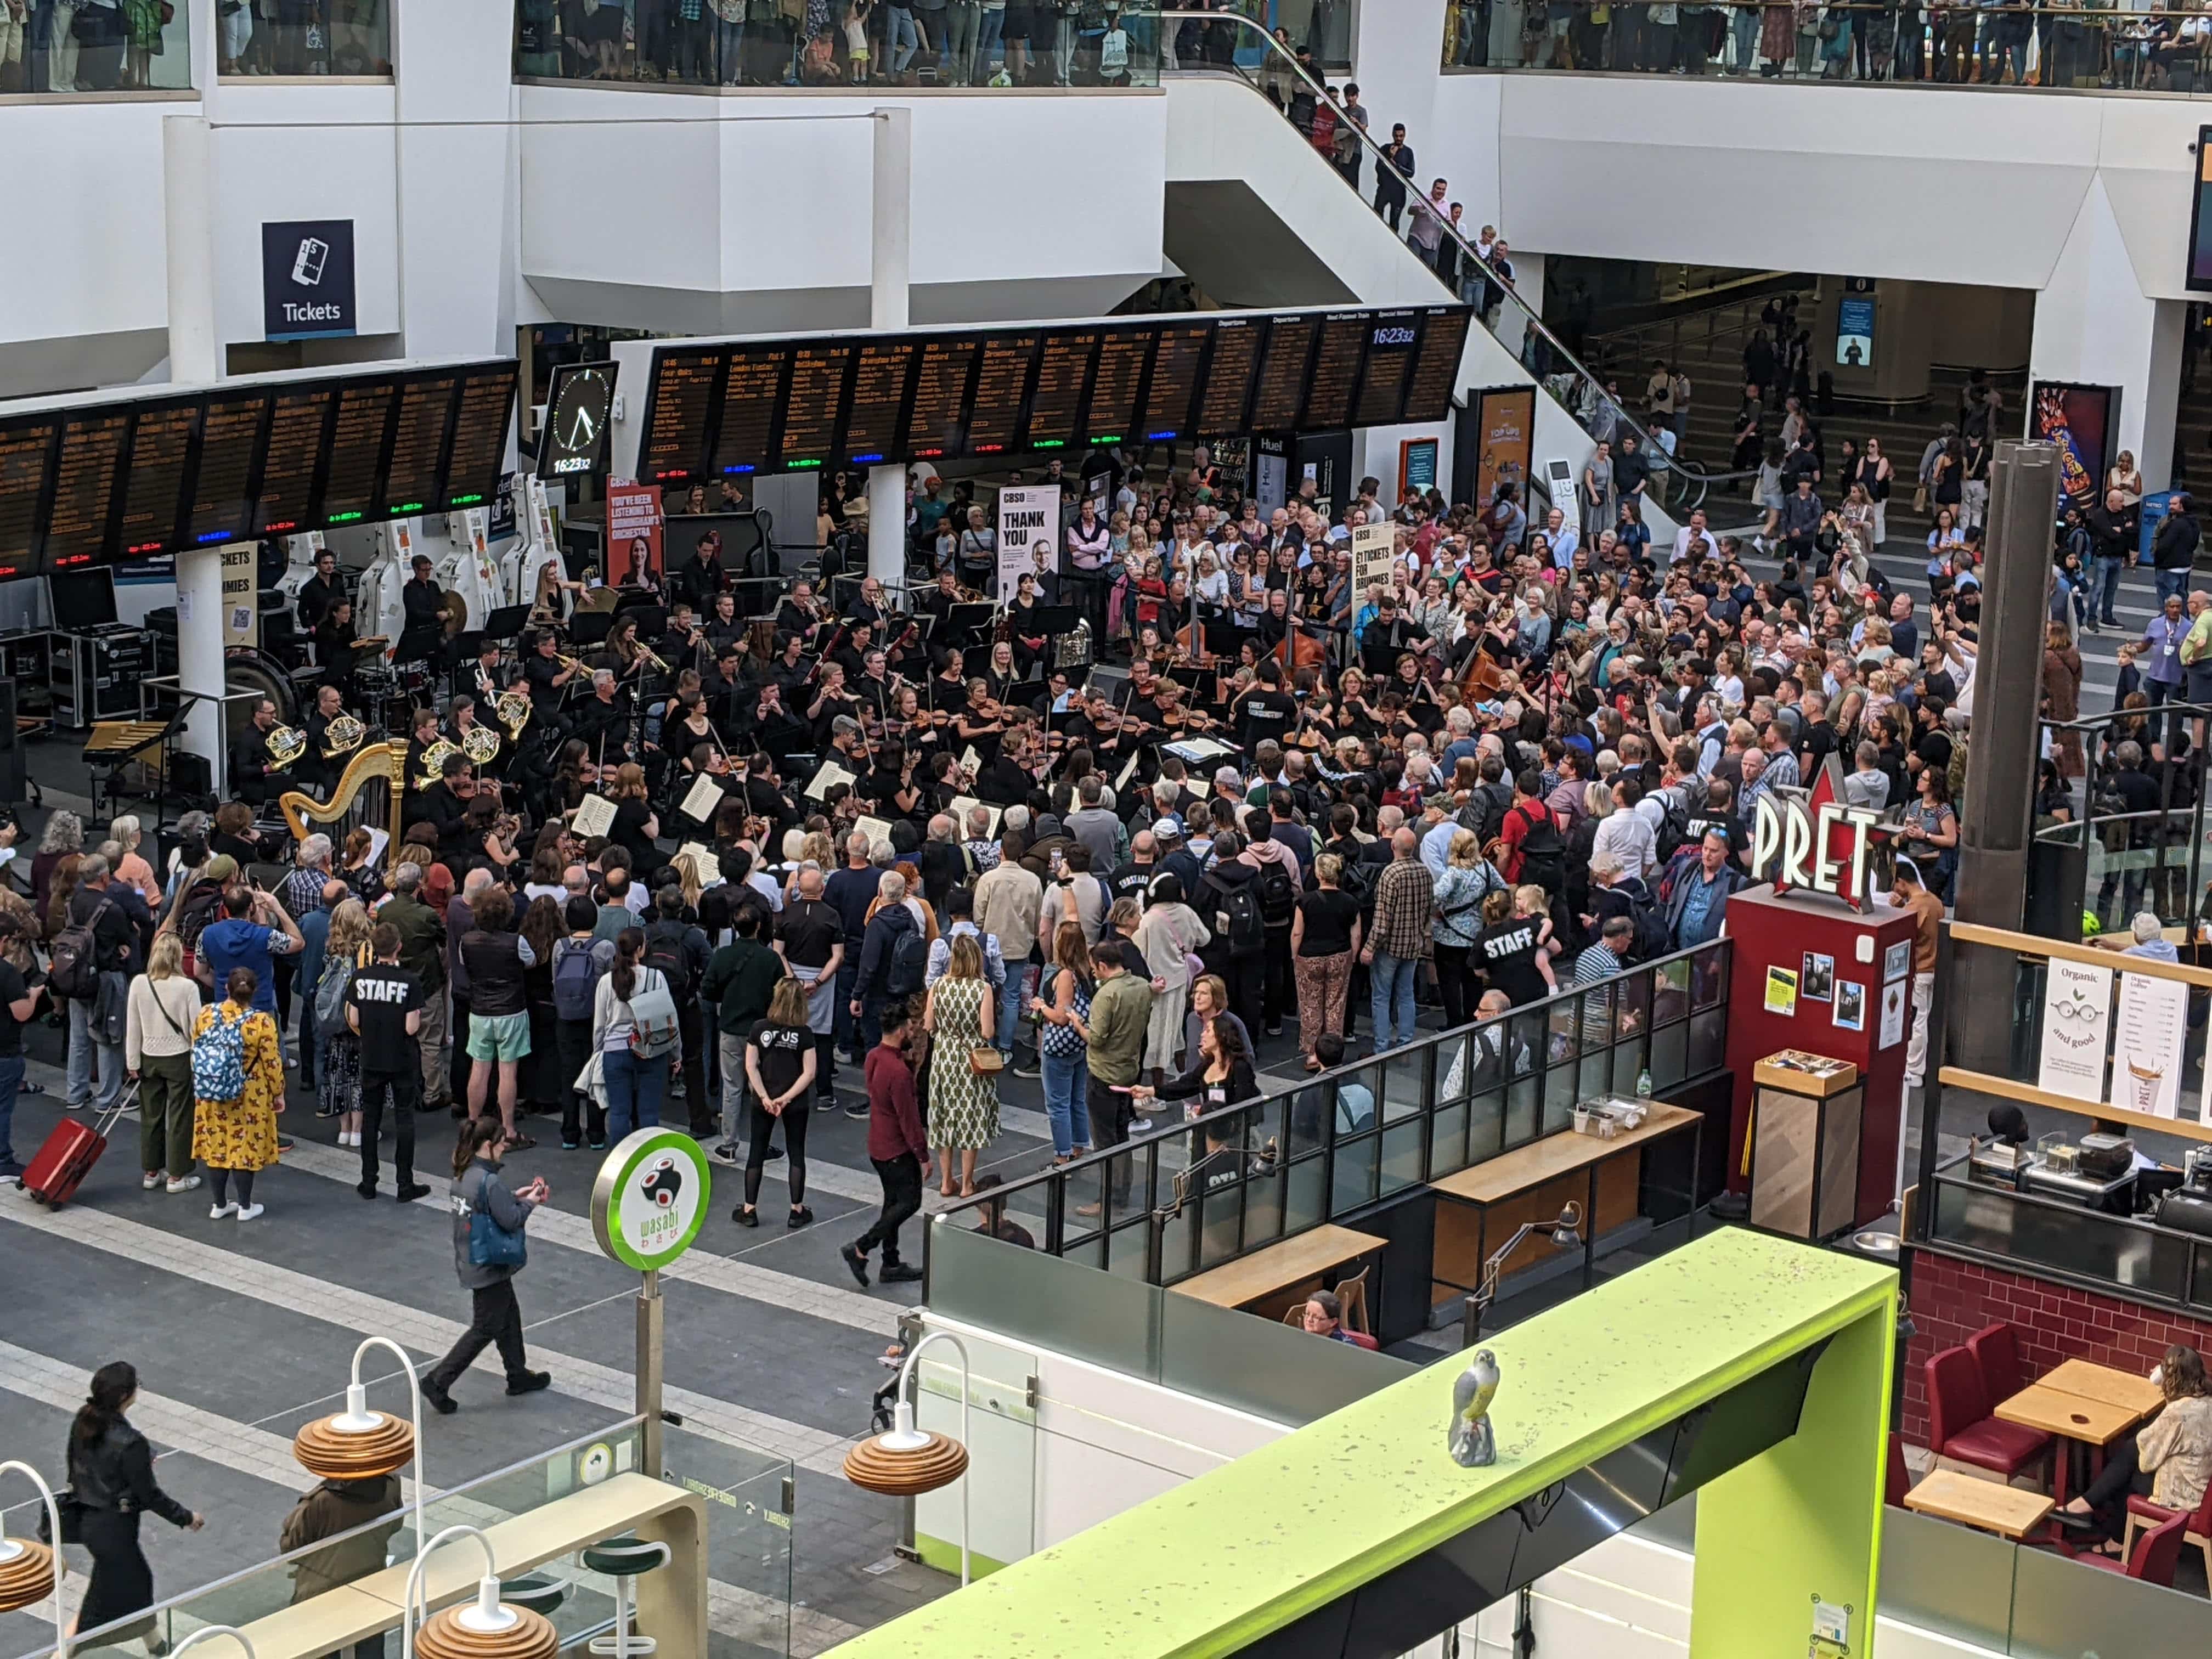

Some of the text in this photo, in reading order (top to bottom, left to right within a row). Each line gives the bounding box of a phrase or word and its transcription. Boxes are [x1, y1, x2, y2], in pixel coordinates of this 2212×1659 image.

[283, 302, 340, 321] Tickets
[1262, 438, 1282, 452] Huel
[1004, 493, 1025, 503] CBSO
[612, 504, 654, 518] LISTENING TO
[1003, 511, 1045, 528] THANK
[1003, 529, 1027, 546] YOU
[1356, 529, 1370, 541] CBSO
[1363, 547, 1389, 562] TICKETS
[1356, 564, 1368, 577] FOR
[1356, 572, 1389, 590] BRUMMIES
[1752, 794, 1876, 898] PRET
[1484, 927, 1532, 958] STAFF
[2061, 968, 2098, 983] Organic
[356, 979, 408, 1004] STAFF
[2053, 1027, 2096, 1048] and good
[2138, 1085, 2151, 1105] PRET
[641, 1205, 678, 1237] wasabi
